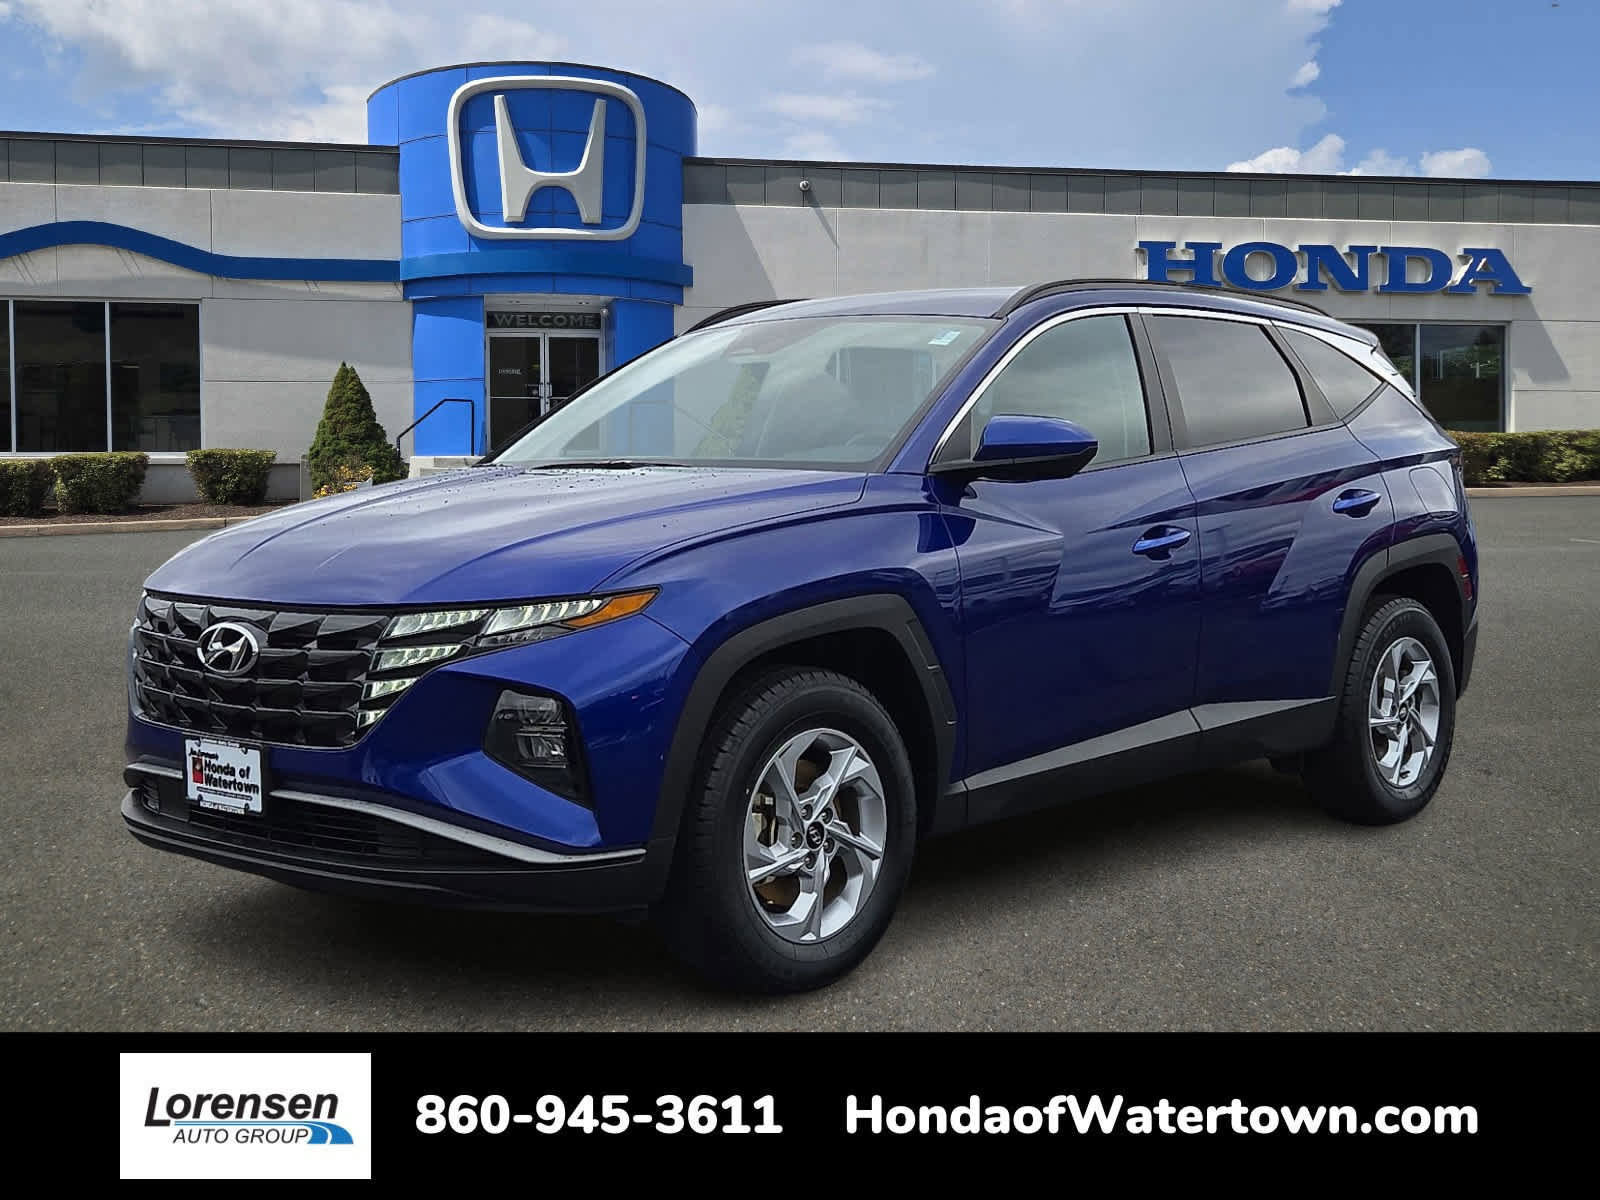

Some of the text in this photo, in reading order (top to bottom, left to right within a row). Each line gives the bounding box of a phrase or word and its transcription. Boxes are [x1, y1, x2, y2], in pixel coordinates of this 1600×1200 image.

[1137, 240, 1532, 296] HONDA
[494, 313, 595, 327] WELCOME
[204, 760, 251, 779] Honda of
[204, 773, 260, 795] Watertown
